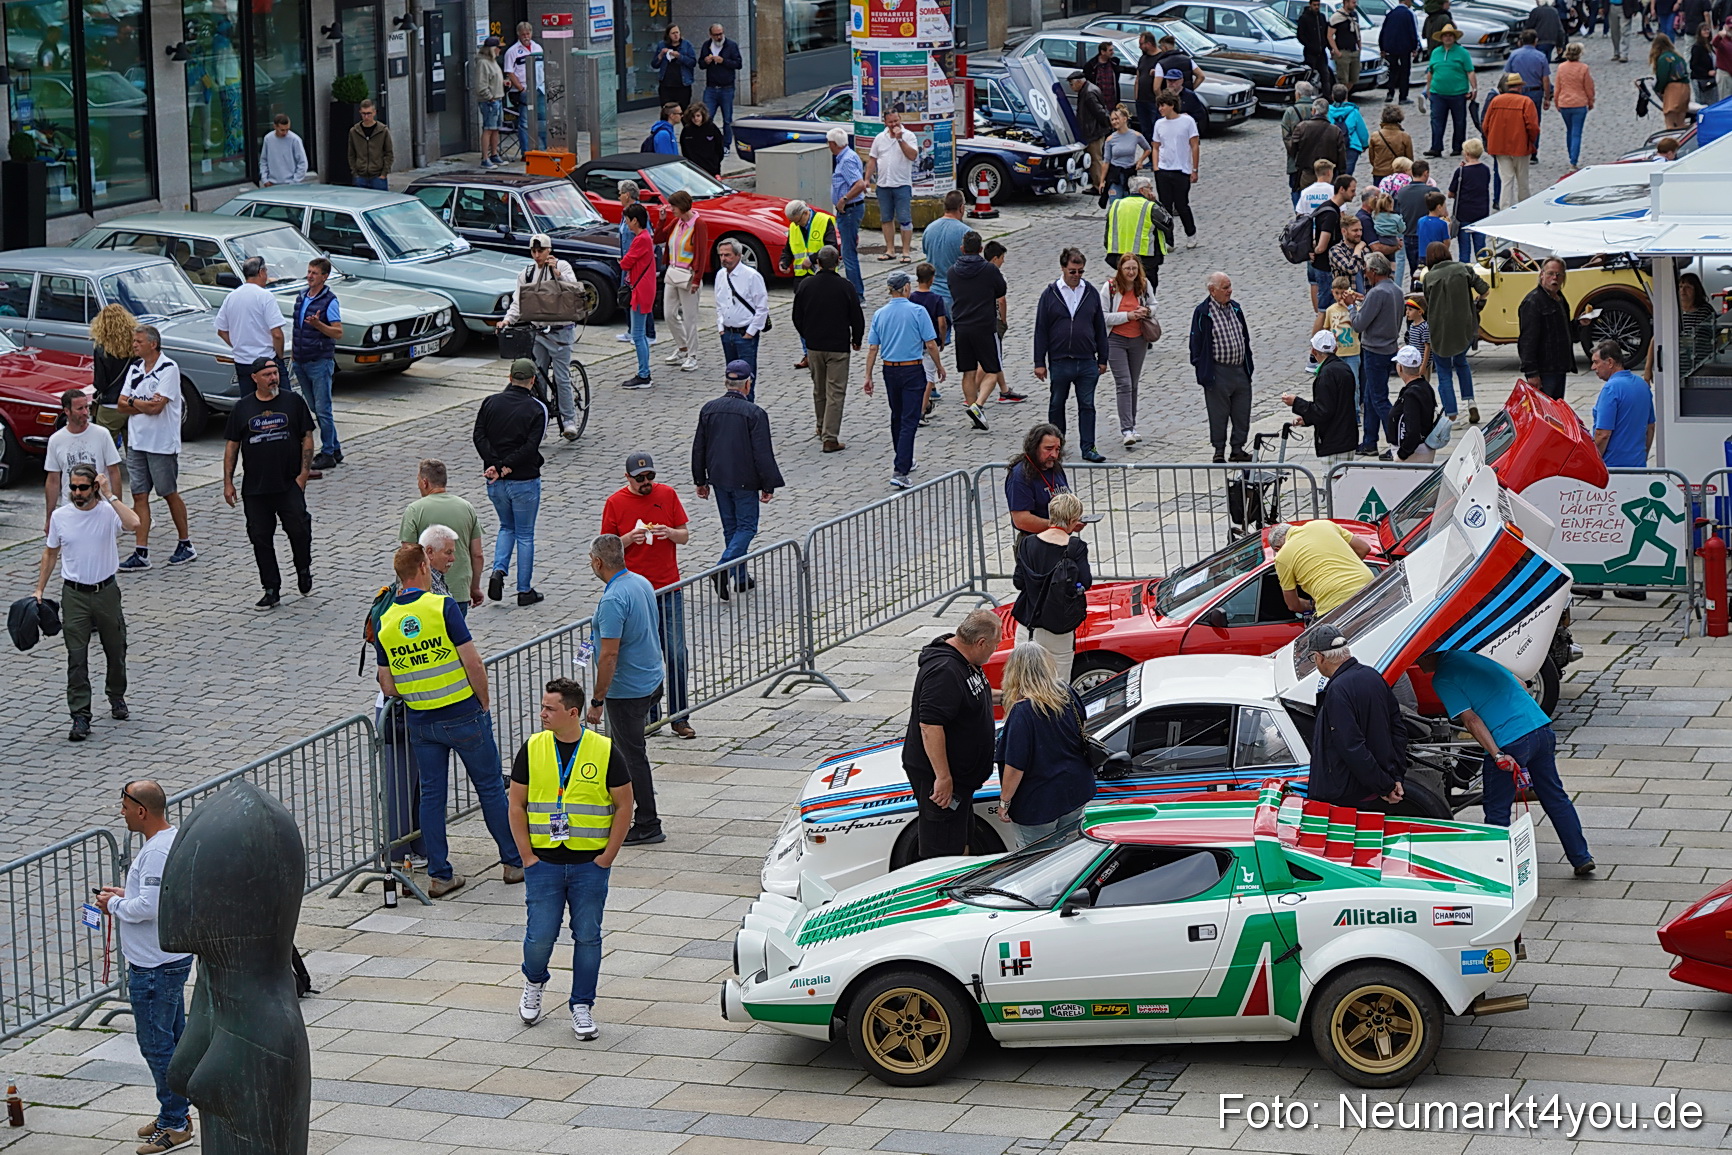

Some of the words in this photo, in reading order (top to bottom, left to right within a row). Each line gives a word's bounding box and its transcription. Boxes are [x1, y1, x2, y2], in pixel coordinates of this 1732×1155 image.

[1586, 490, 1618, 502] UNS
[390, 636, 442, 657] FOLLOW
[410, 653, 430, 666] ME
[805, 816, 907, 837] pininfarina
[1333, 908, 1418, 927] Alitalia
[1435, 911, 1472, 920] CHAMPION
[999, 957, 1033, 978] HF
[1461, 959, 1484, 967] BILSTEIN
[789, 974, 831, 989] Alitalia
[1021, 1006, 1043, 1016] Agip
[1093, 1005, 1128, 1015] Britax
